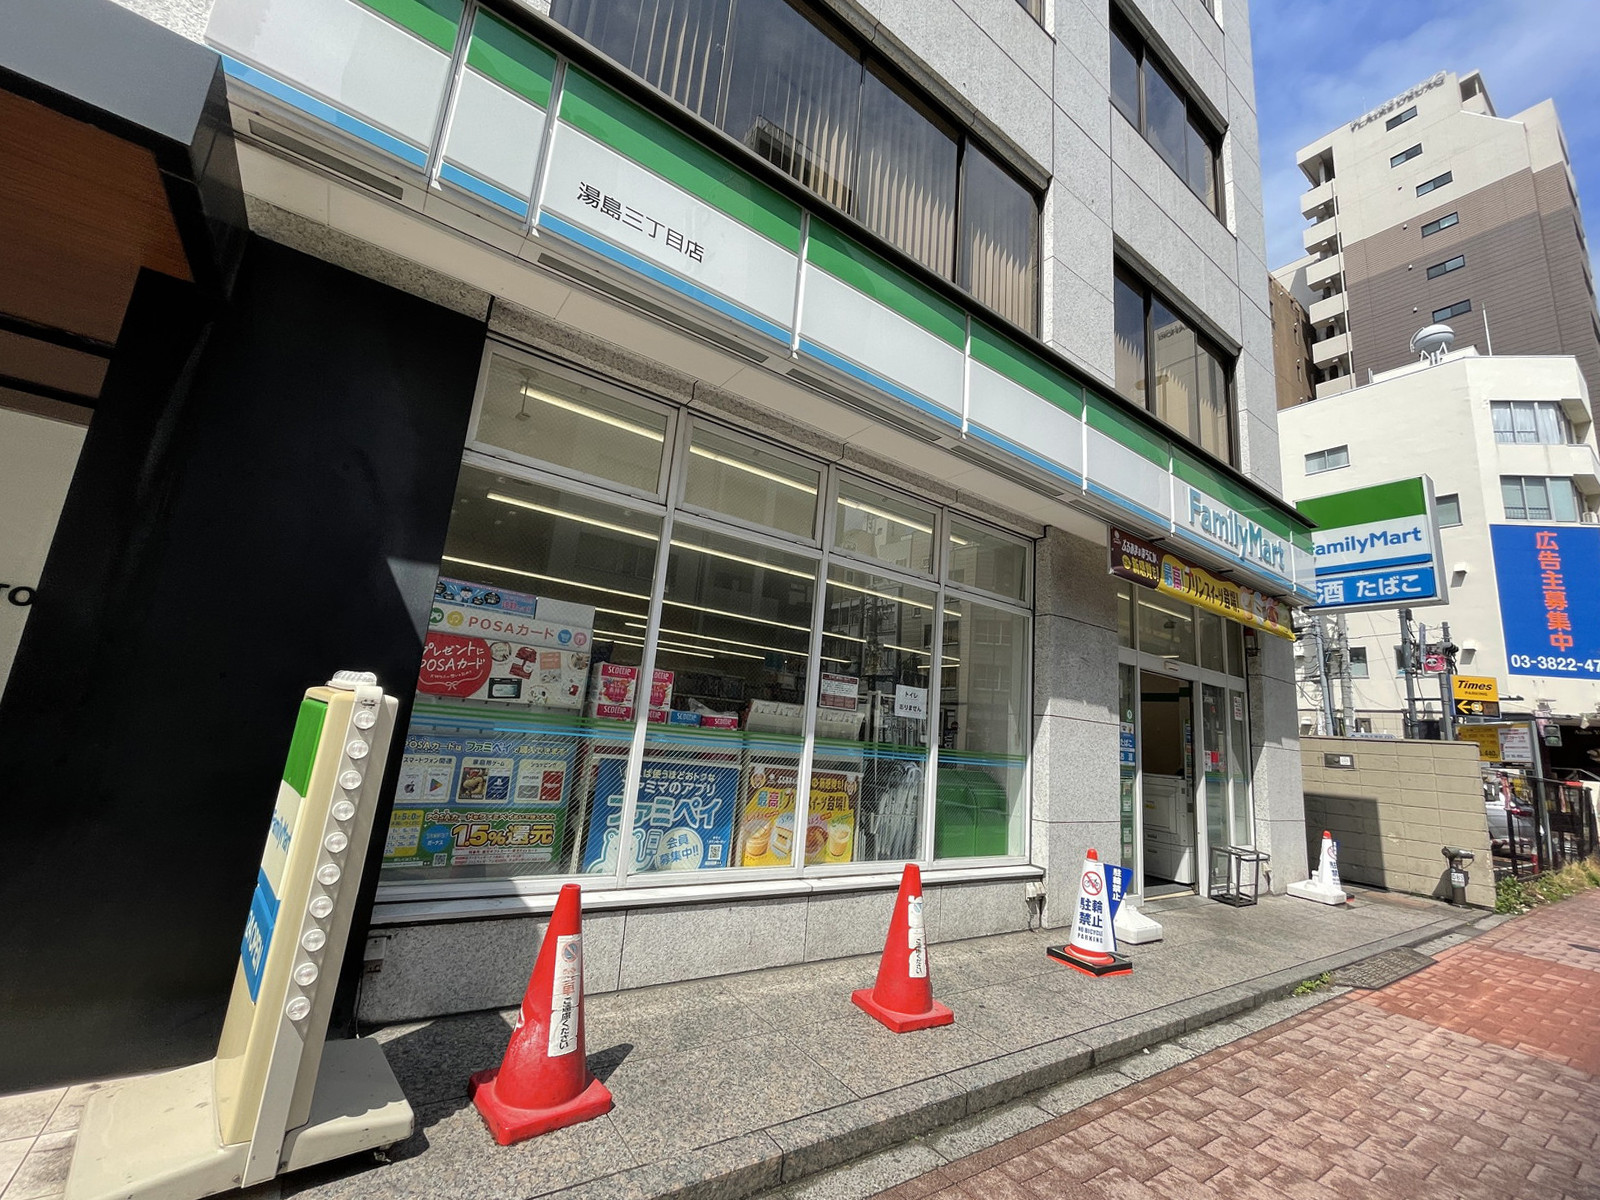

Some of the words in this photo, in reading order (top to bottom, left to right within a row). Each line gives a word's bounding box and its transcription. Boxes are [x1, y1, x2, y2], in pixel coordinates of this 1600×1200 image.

[577, 181, 705, 263] 湯島三丁目店
[1188, 487, 1285, 573] FamilyMart
[1313, 526, 1422, 555] amilyMart
[1316, 579, 1345, 604] 酒
[1356, 574, 1422, 598] たばこ
[1535, 530, 1573, 652] 広告主募集中
[468, 616, 555, 639] POSAカード
[422, 640, 486, 656] プレゼントに
[1457, 680, 1493, 691] Times
[904, 691, 919, 699] トイレ
[899, 705, 922, 713] ありません
[452, 823, 555, 848] 1.5%還元
[665, 833, 690, 848] 会員
[1079, 897, 1103, 914] 駐輪
[1079, 911, 1103, 928] 禁止
[1077, 932, 1103, 943] PARKING
[1085, 927, 1103, 937] BICYCLE
